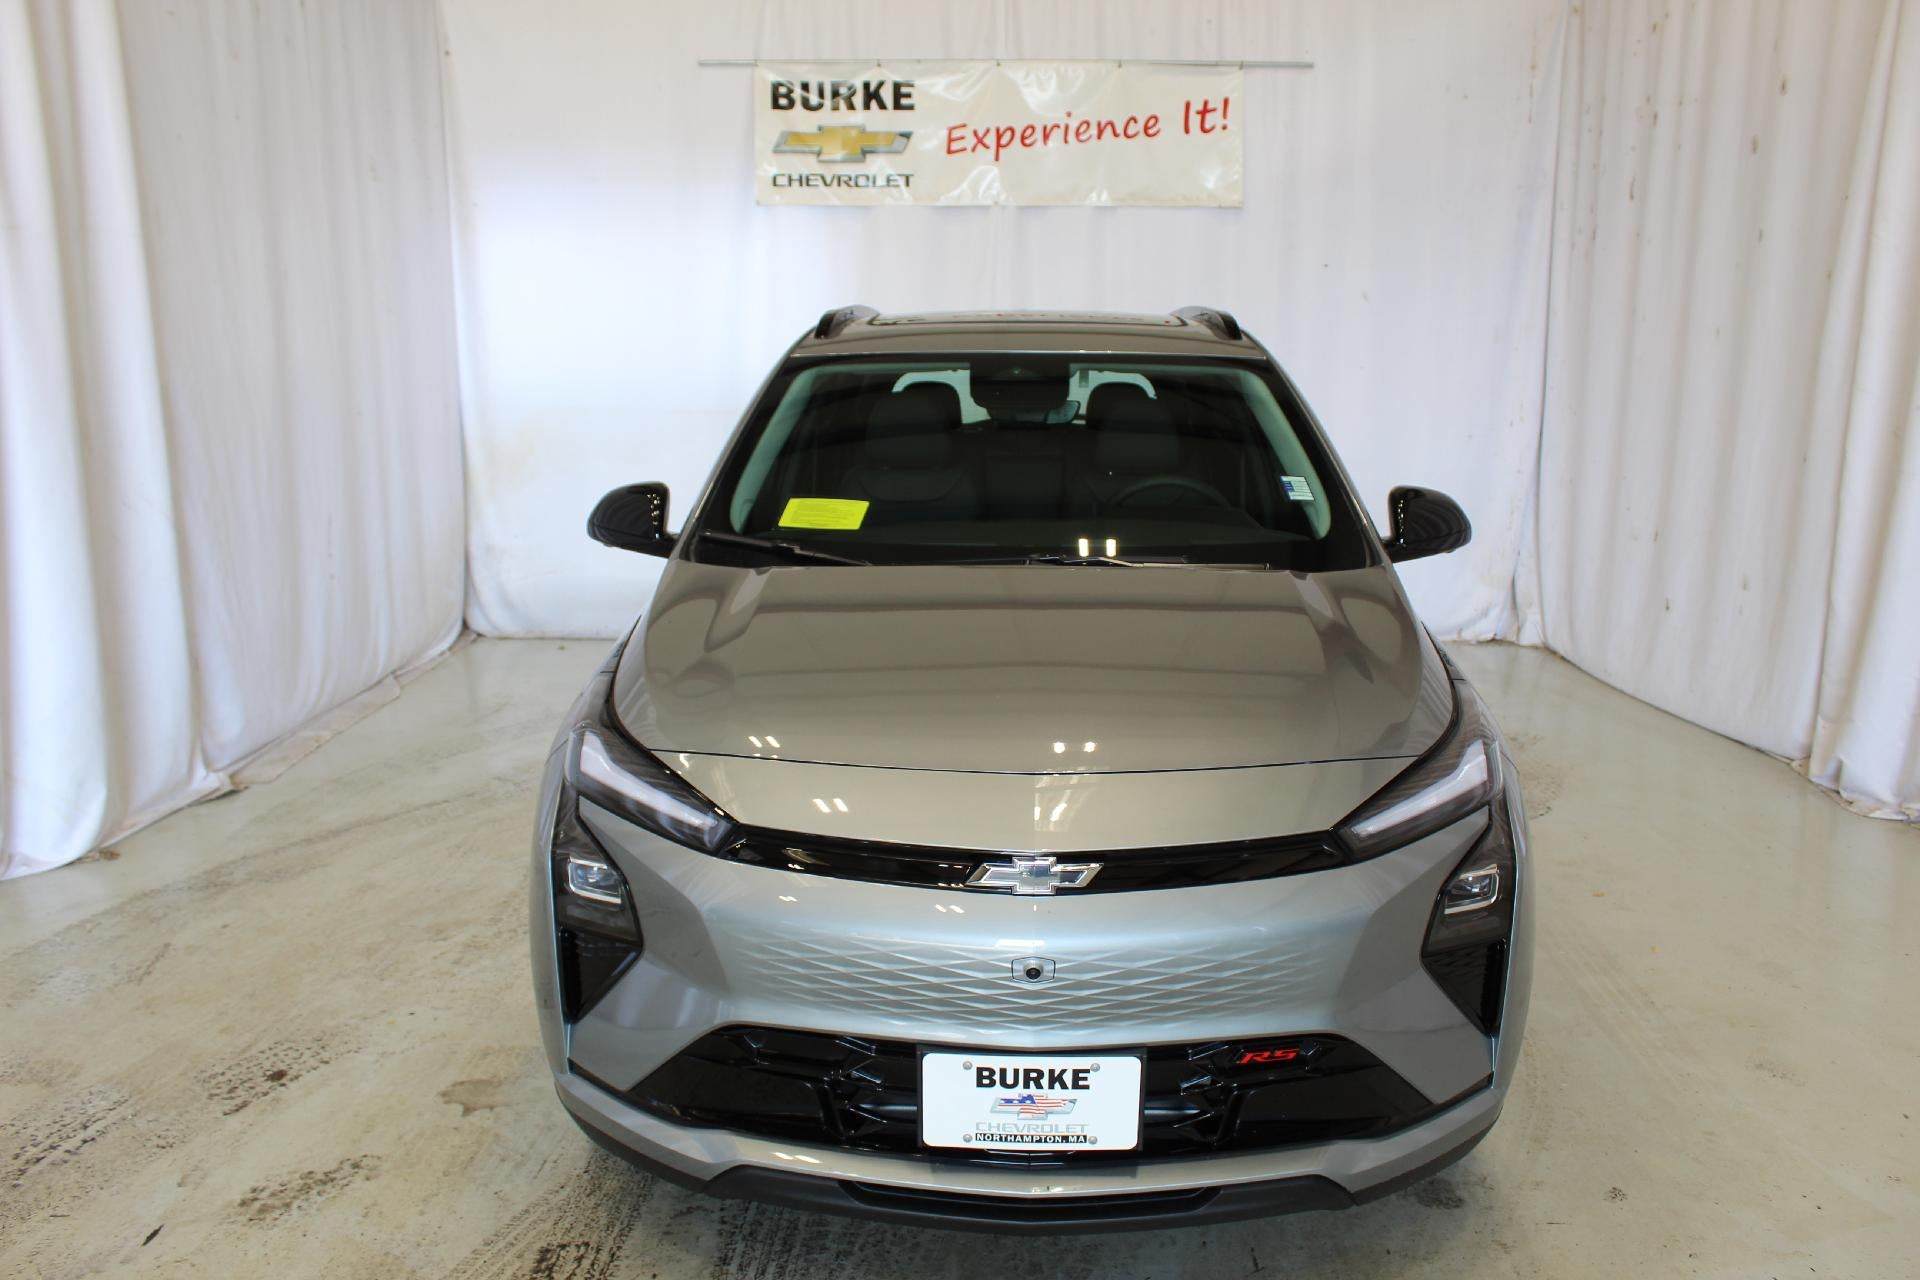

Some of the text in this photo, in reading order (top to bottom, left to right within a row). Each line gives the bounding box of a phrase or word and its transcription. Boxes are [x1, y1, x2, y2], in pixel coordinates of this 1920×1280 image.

[770, 79, 916, 111] BURKE
[945, 96, 1232, 162] Experience It!
[771, 173, 915, 188] CHEVROLET
[1239, 1047, 1300, 1064] RS
[975, 1066, 1091, 1090] BURKE
[976, 1122, 1088, 1133] CHEVROLET
[1068, 1135, 1085, 1143] MA
